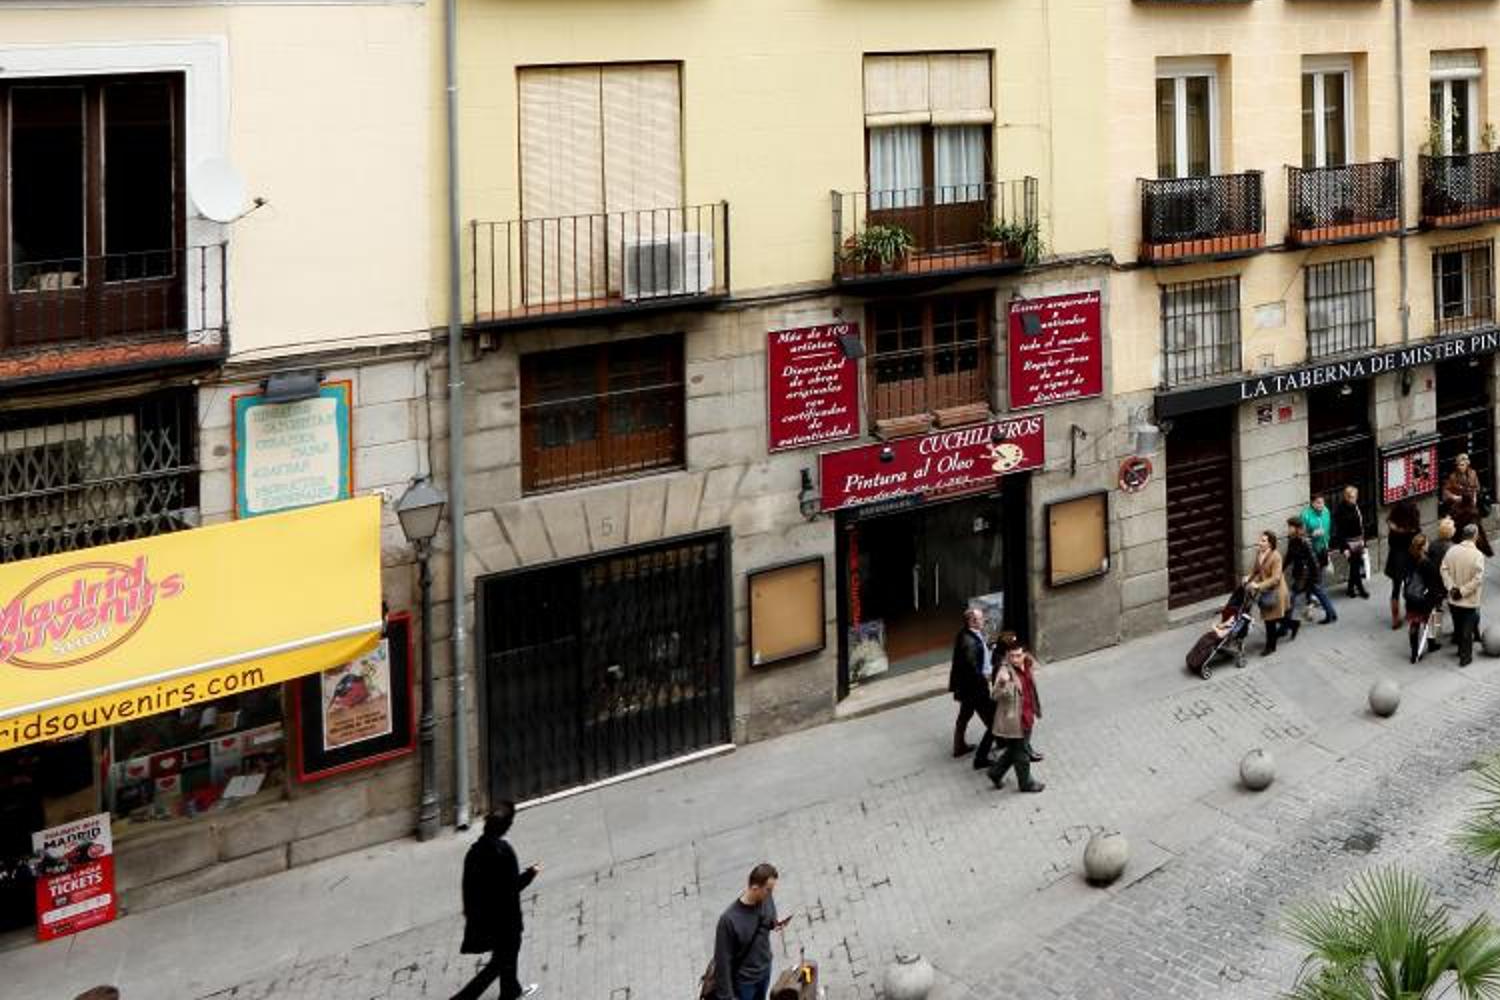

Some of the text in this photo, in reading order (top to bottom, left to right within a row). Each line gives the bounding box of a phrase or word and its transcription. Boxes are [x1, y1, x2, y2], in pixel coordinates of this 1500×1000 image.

[806, 327, 821, 339] de
[782, 356, 846, 377] Diversidad
[1240, 380, 1268, 399] LA
[1272, 361, 1366, 393] TABERNA
[1370, 353, 1396, 373] DE
[1400, 339, 1465, 367] MISTER
[785, 381, 842, 399] originales
[789, 372, 839, 387] de obras
[778, 423, 851, 446] autenticidad
[842, 471, 907, 493] Pintura
[913, 458, 931, 479] al
[0, 553, 148, 635] Madrid
[44, 827, 101, 849] MADRID
[48, 871, 104, 897] TICKETS
